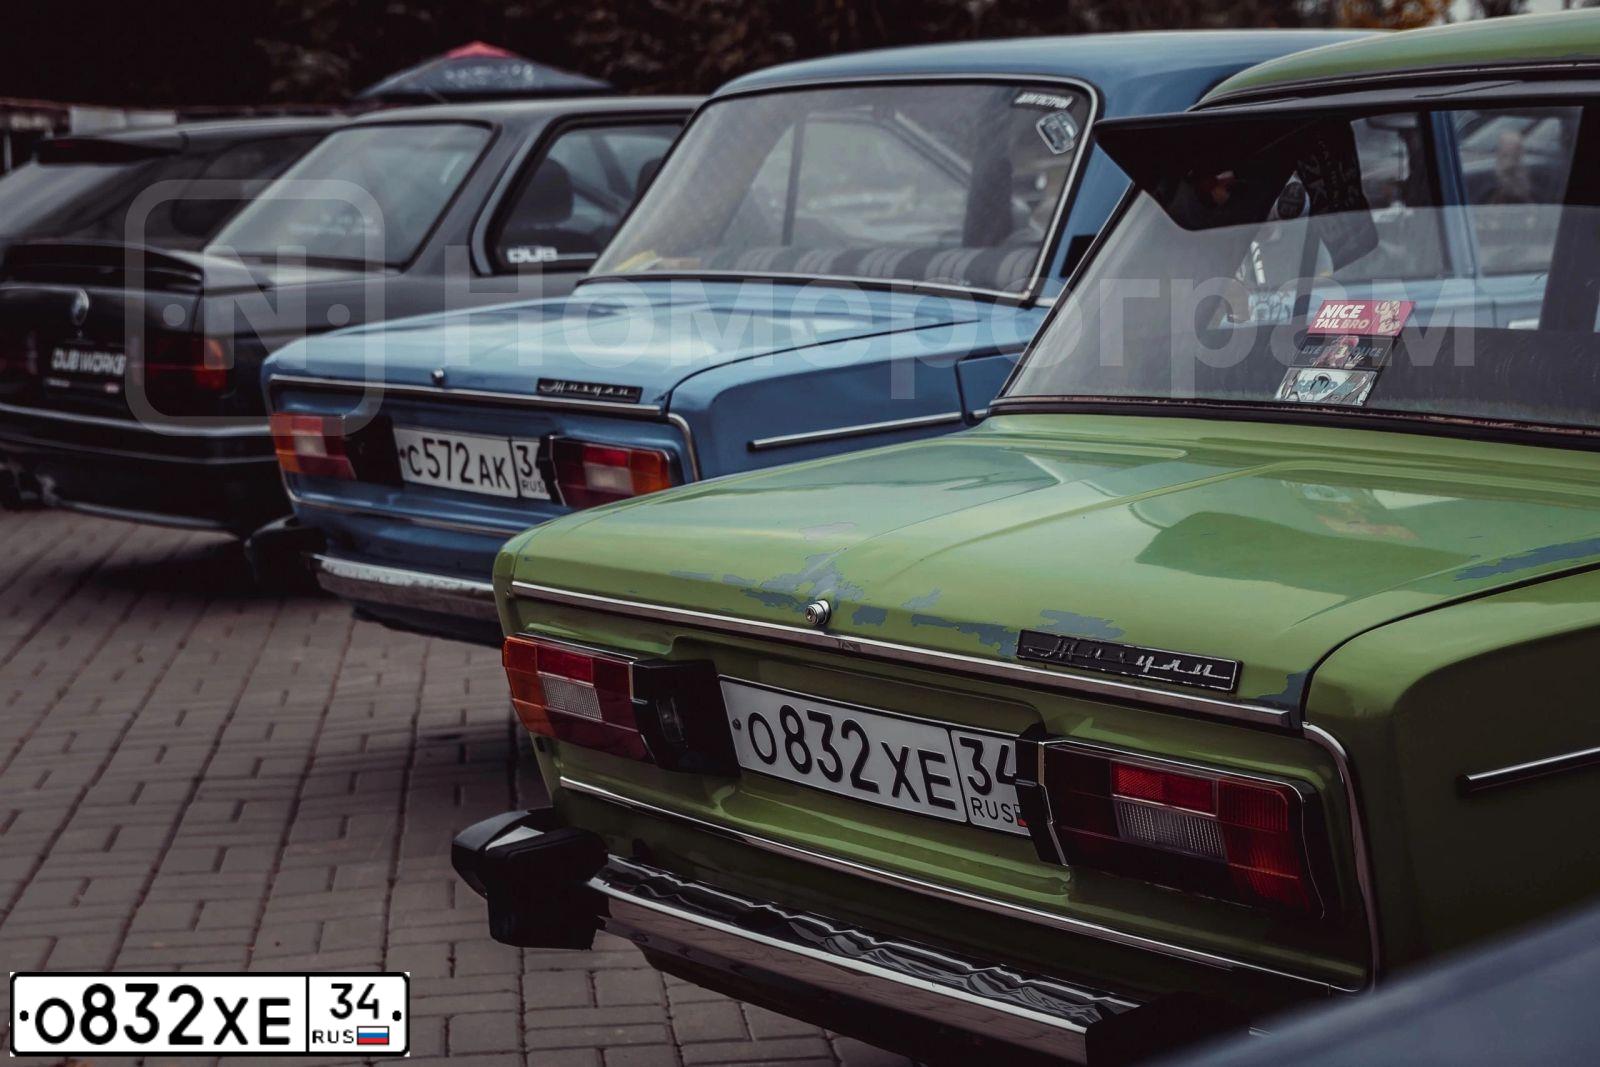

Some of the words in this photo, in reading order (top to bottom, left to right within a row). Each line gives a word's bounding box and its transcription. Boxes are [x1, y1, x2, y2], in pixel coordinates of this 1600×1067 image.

[1319, 304, 1365, 319] NICE
[1314, 318, 1340, 329] TAIL
[1339, 318, 1370, 330] BRO
[407, 438, 511, 490] С572АК
[516, 445, 540, 478] 3
[521, 480, 545, 493] RUS
[747, 704, 957, 811] О832ХЕ
[971, 797, 1014, 823] RUS
